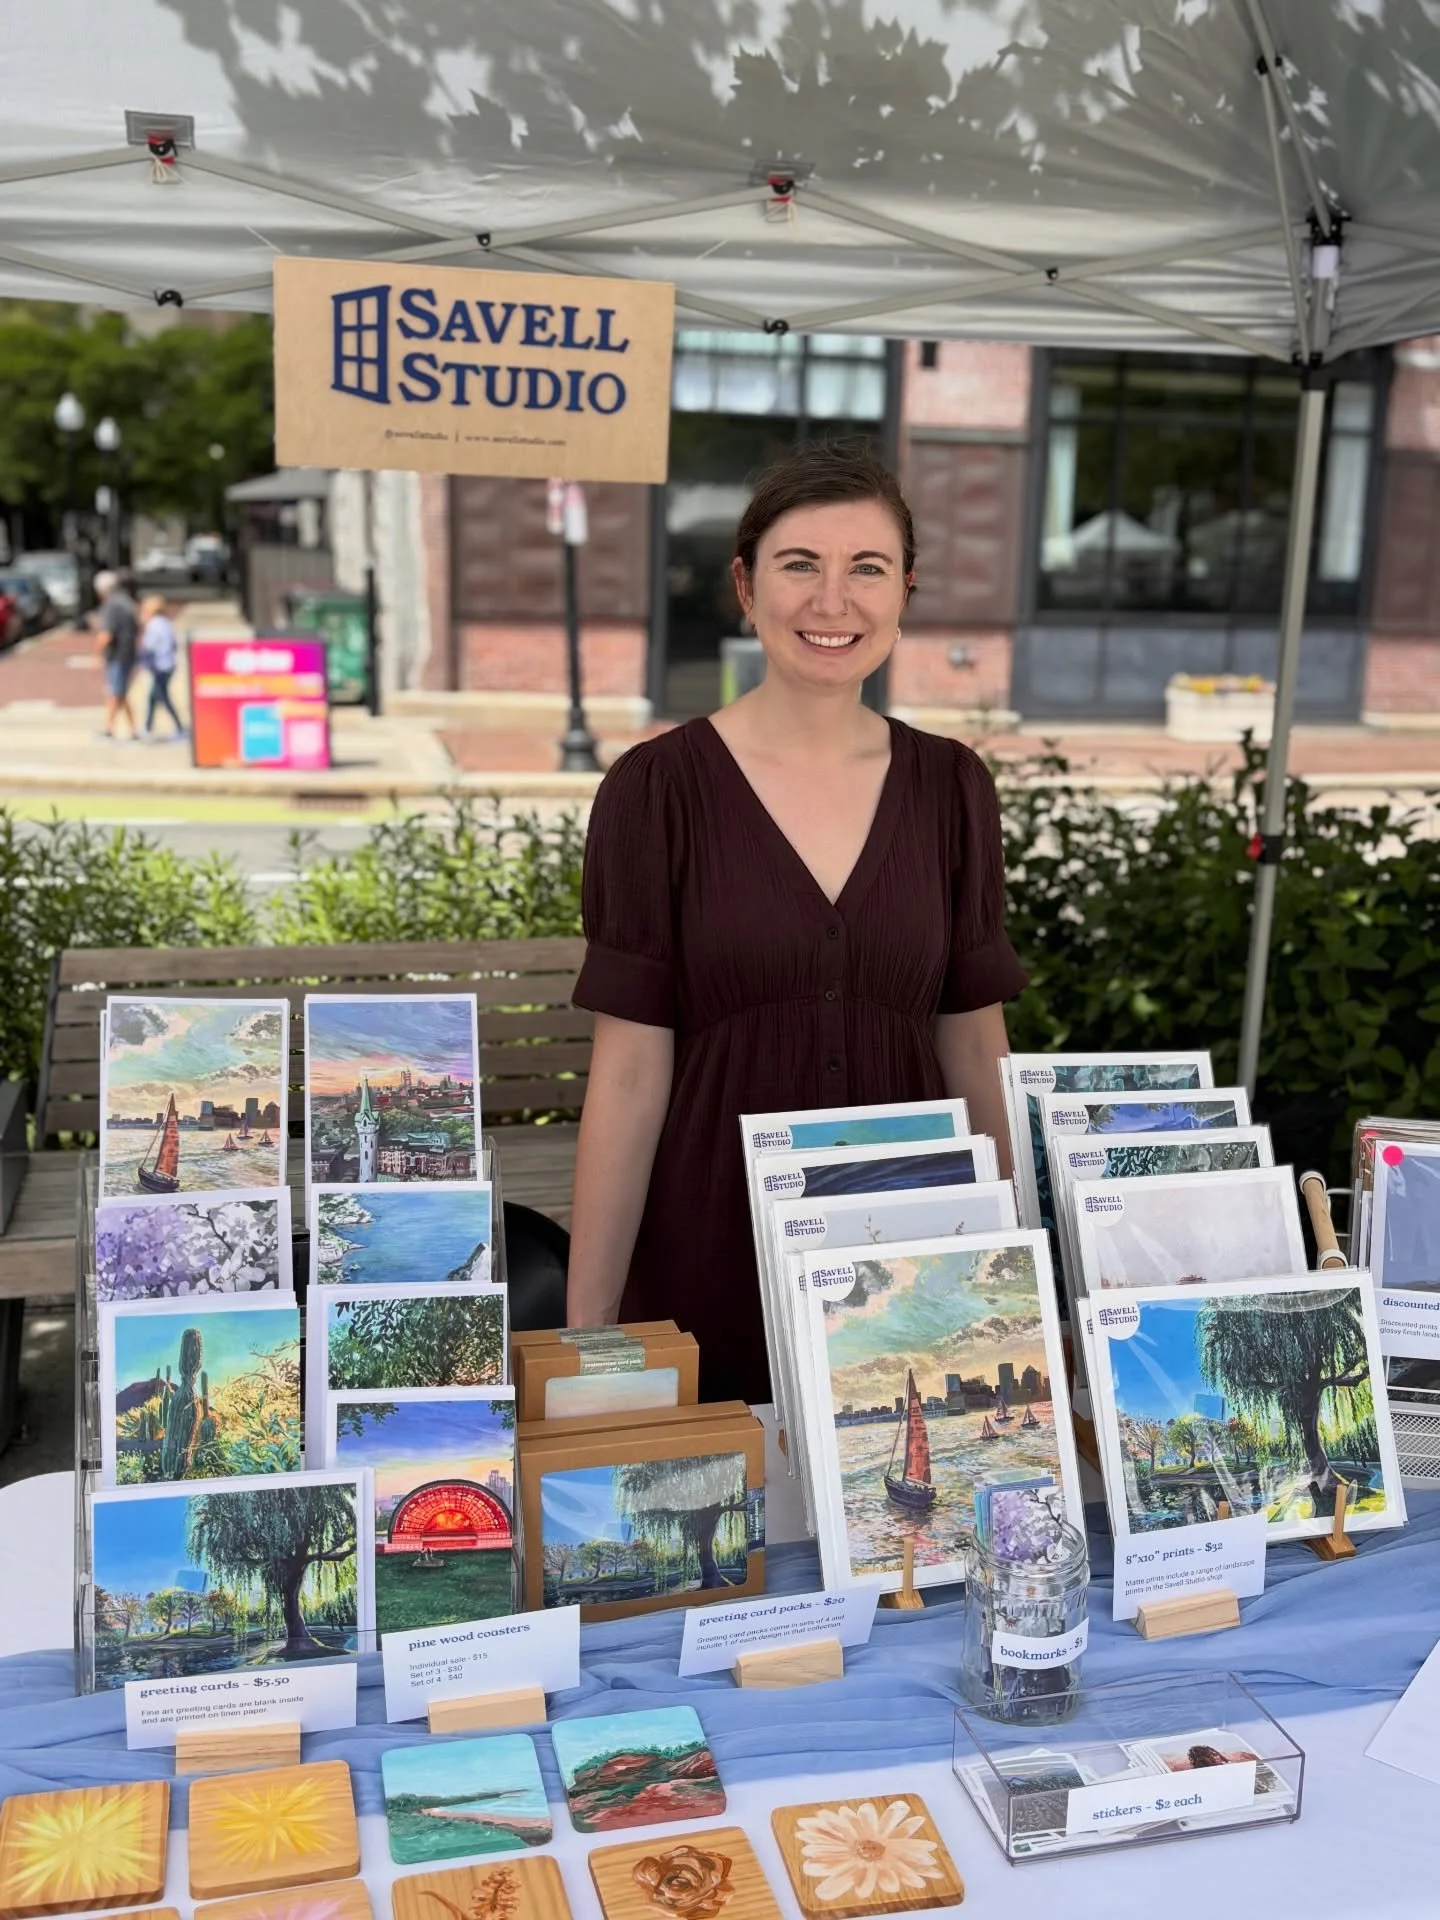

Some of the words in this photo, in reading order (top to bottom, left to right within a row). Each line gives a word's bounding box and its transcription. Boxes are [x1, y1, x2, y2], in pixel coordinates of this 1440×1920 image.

[397, 288, 630, 352] SAVELL
[398, 352, 626, 414] STUDIO
[760, 1131, 790, 1140] SAVELL
[762, 1139, 791, 1147] STUDIO
[772, 1172, 802, 1182] SAVELL
[774, 1181, 804, 1191] STUDIO
[792, 1218, 824, 1228] SAVELL
[794, 1226, 825, 1236] STUDIO
[820, 1267, 853, 1278] SAVELL
[822, 1276, 854, 1286] STUDIO
[1382, 1298, 1440, 1310] discounted
[1106, 1307, 1137, 1316] SAVELL
[1108, 1316, 1139, 1324] STUDIO
[1162, 1546, 1195, 1561] prints
[1204, 1542, 1223, 1553] $32
[1125, 1578, 1145, 1586] Matte
[1146, 1576, 1164, 1584] prints
[1166, 1571, 1189, 1579] include
[1222, 1560, 1255, 1570] landscape
[1125, 1587, 1144, 1596] prints
[1165, 1580, 1184, 1589] Savell
[1185, 1576, 1206, 1585] Studio
[699, 1612, 748, 1626] greeting
[750, 1607, 776, 1618] card
[779, 1602, 812, 1615] packs
[823, 1597, 845, 1606] $20
[408, 1639, 436, 1652] pine
[440, 1632, 474, 1644] wood
[477, 1624, 531, 1639] coasters
[695, 1642, 722, 1650] include
[739, 1635, 757, 1643] each
[759, 1632, 782, 1641] design
[697, 1634, 728, 1644] Greeting
[746, 1627, 768, 1636] packs
[1000, 1646, 1067, 1660] bookmarks
[409, 1659, 448, 1671] Individual
[472, 1653, 488, 1661] $15
[410, 1671, 423, 1679] Set
[448, 1665, 462, 1673] $30
[140, 1685, 198, 1698] greeting
[200, 1680, 240, 1691] cards
[253, 1676, 290, 1687] $5.50
[410, 1679, 424, 1687] Set
[176, 1705, 211, 1715] greeting
[213, 1702, 237, 1711] cards
[254, 1698, 277, 1706] blank
[279, 1695, 304, 1704] inside
[175, 1713, 206, 1723] printed
[1093, 1805, 1142, 1820] stickers
[1155, 1799, 1171, 1810] $2
[1174, 1794, 1202, 1807] each
